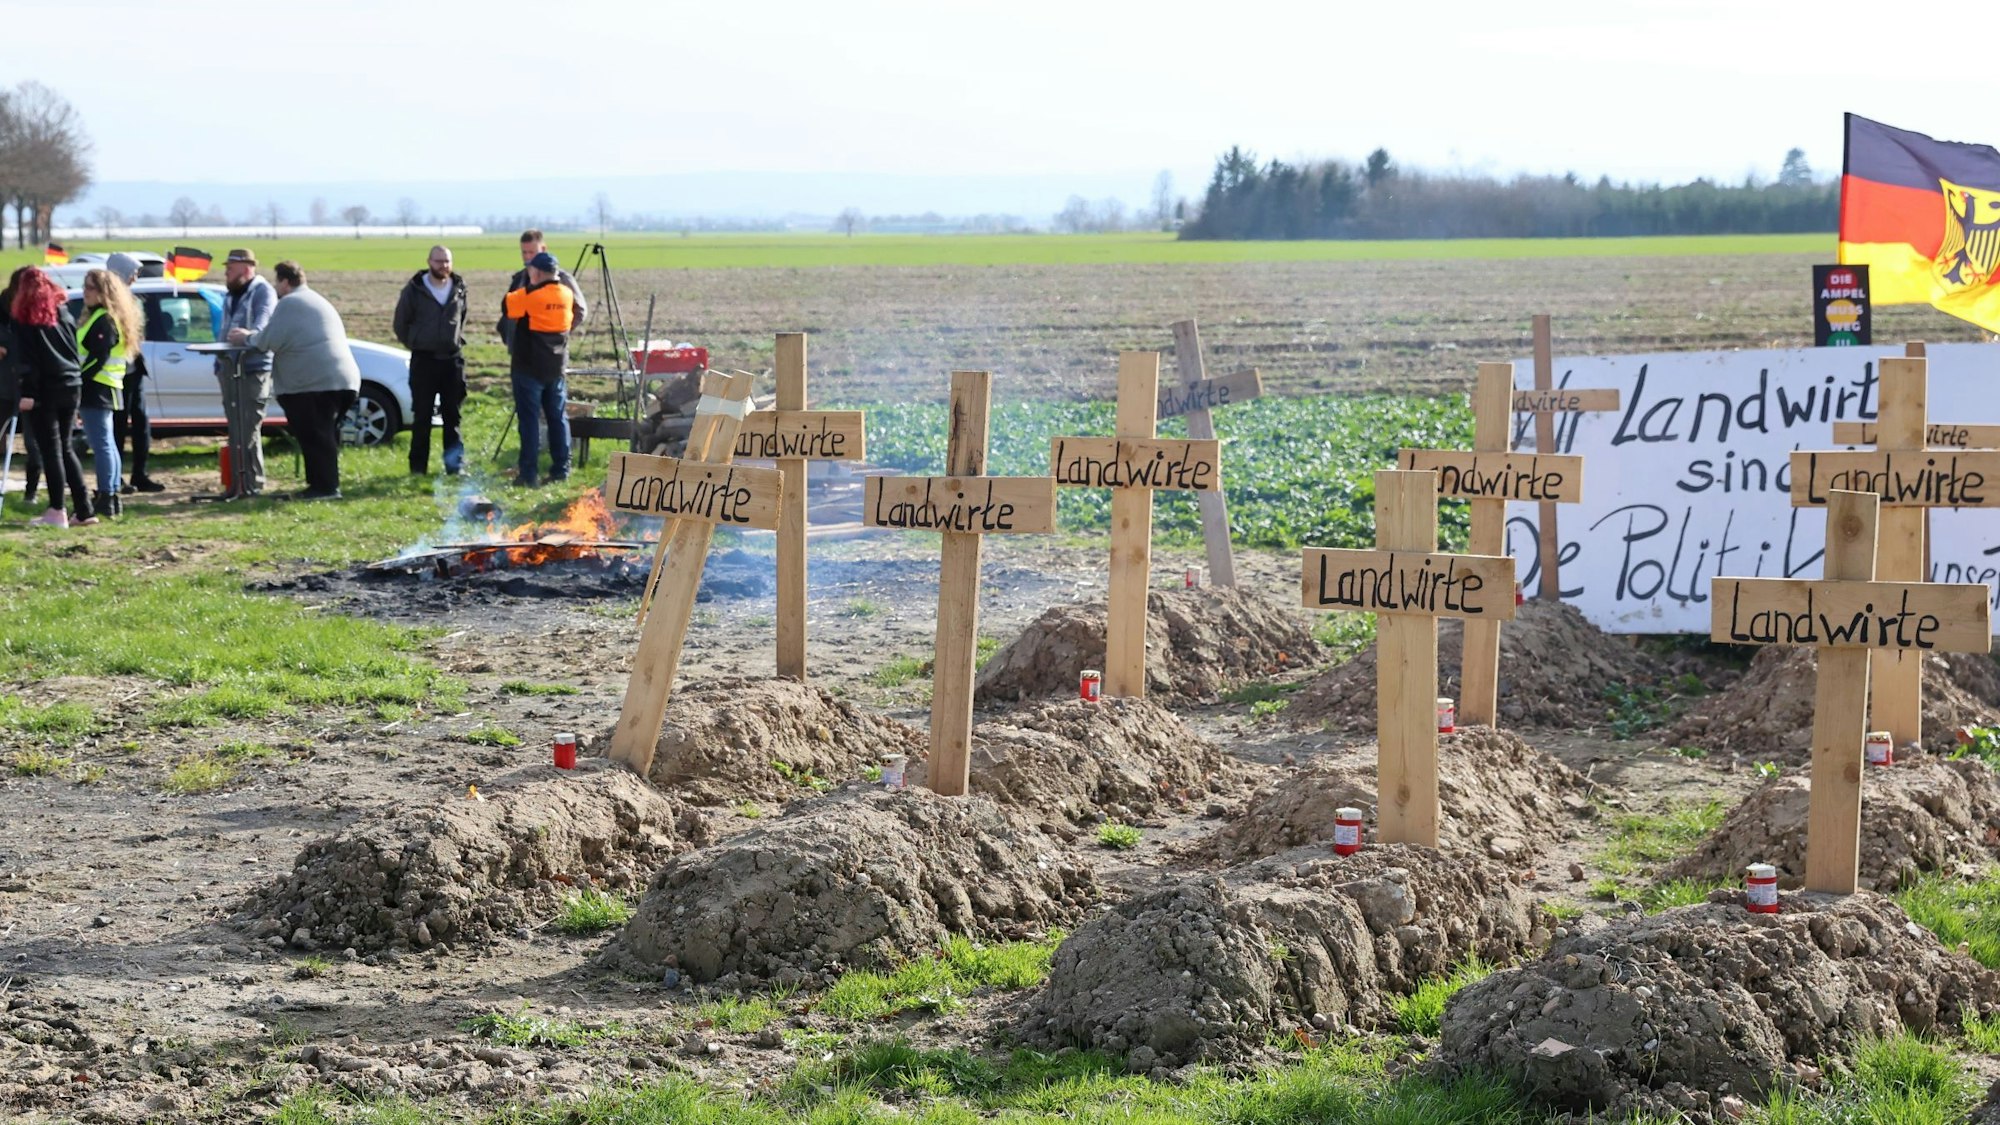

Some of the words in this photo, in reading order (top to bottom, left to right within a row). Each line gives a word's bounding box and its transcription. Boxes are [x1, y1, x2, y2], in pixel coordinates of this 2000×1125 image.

[1820, 288, 1866, 299] AMPEL
[1830, 274, 1852, 285] DIE
[1826, 304, 1863, 315] MUSS
[1830, 321, 1861, 332] WEG
[1157, 379, 1230, 418] ndwirte
[1511, 391, 1580, 411] dwirte
[1612, 362, 1878, 446] Landwirt
[734, 416, 845, 457] andwirte
[615, 456, 751, 522] Landwirte
[1056, 441, 1211, 490] Landwirte
[1409, 453, 1563, 500] ndwirte
[1808, 453, 1985, 504] Landwirte
[875, 477, 1014, 531] Landwirte
[1319, 553, 1483, 613] Landwirte
[1730, 582, 1940, 648] Landwirte
